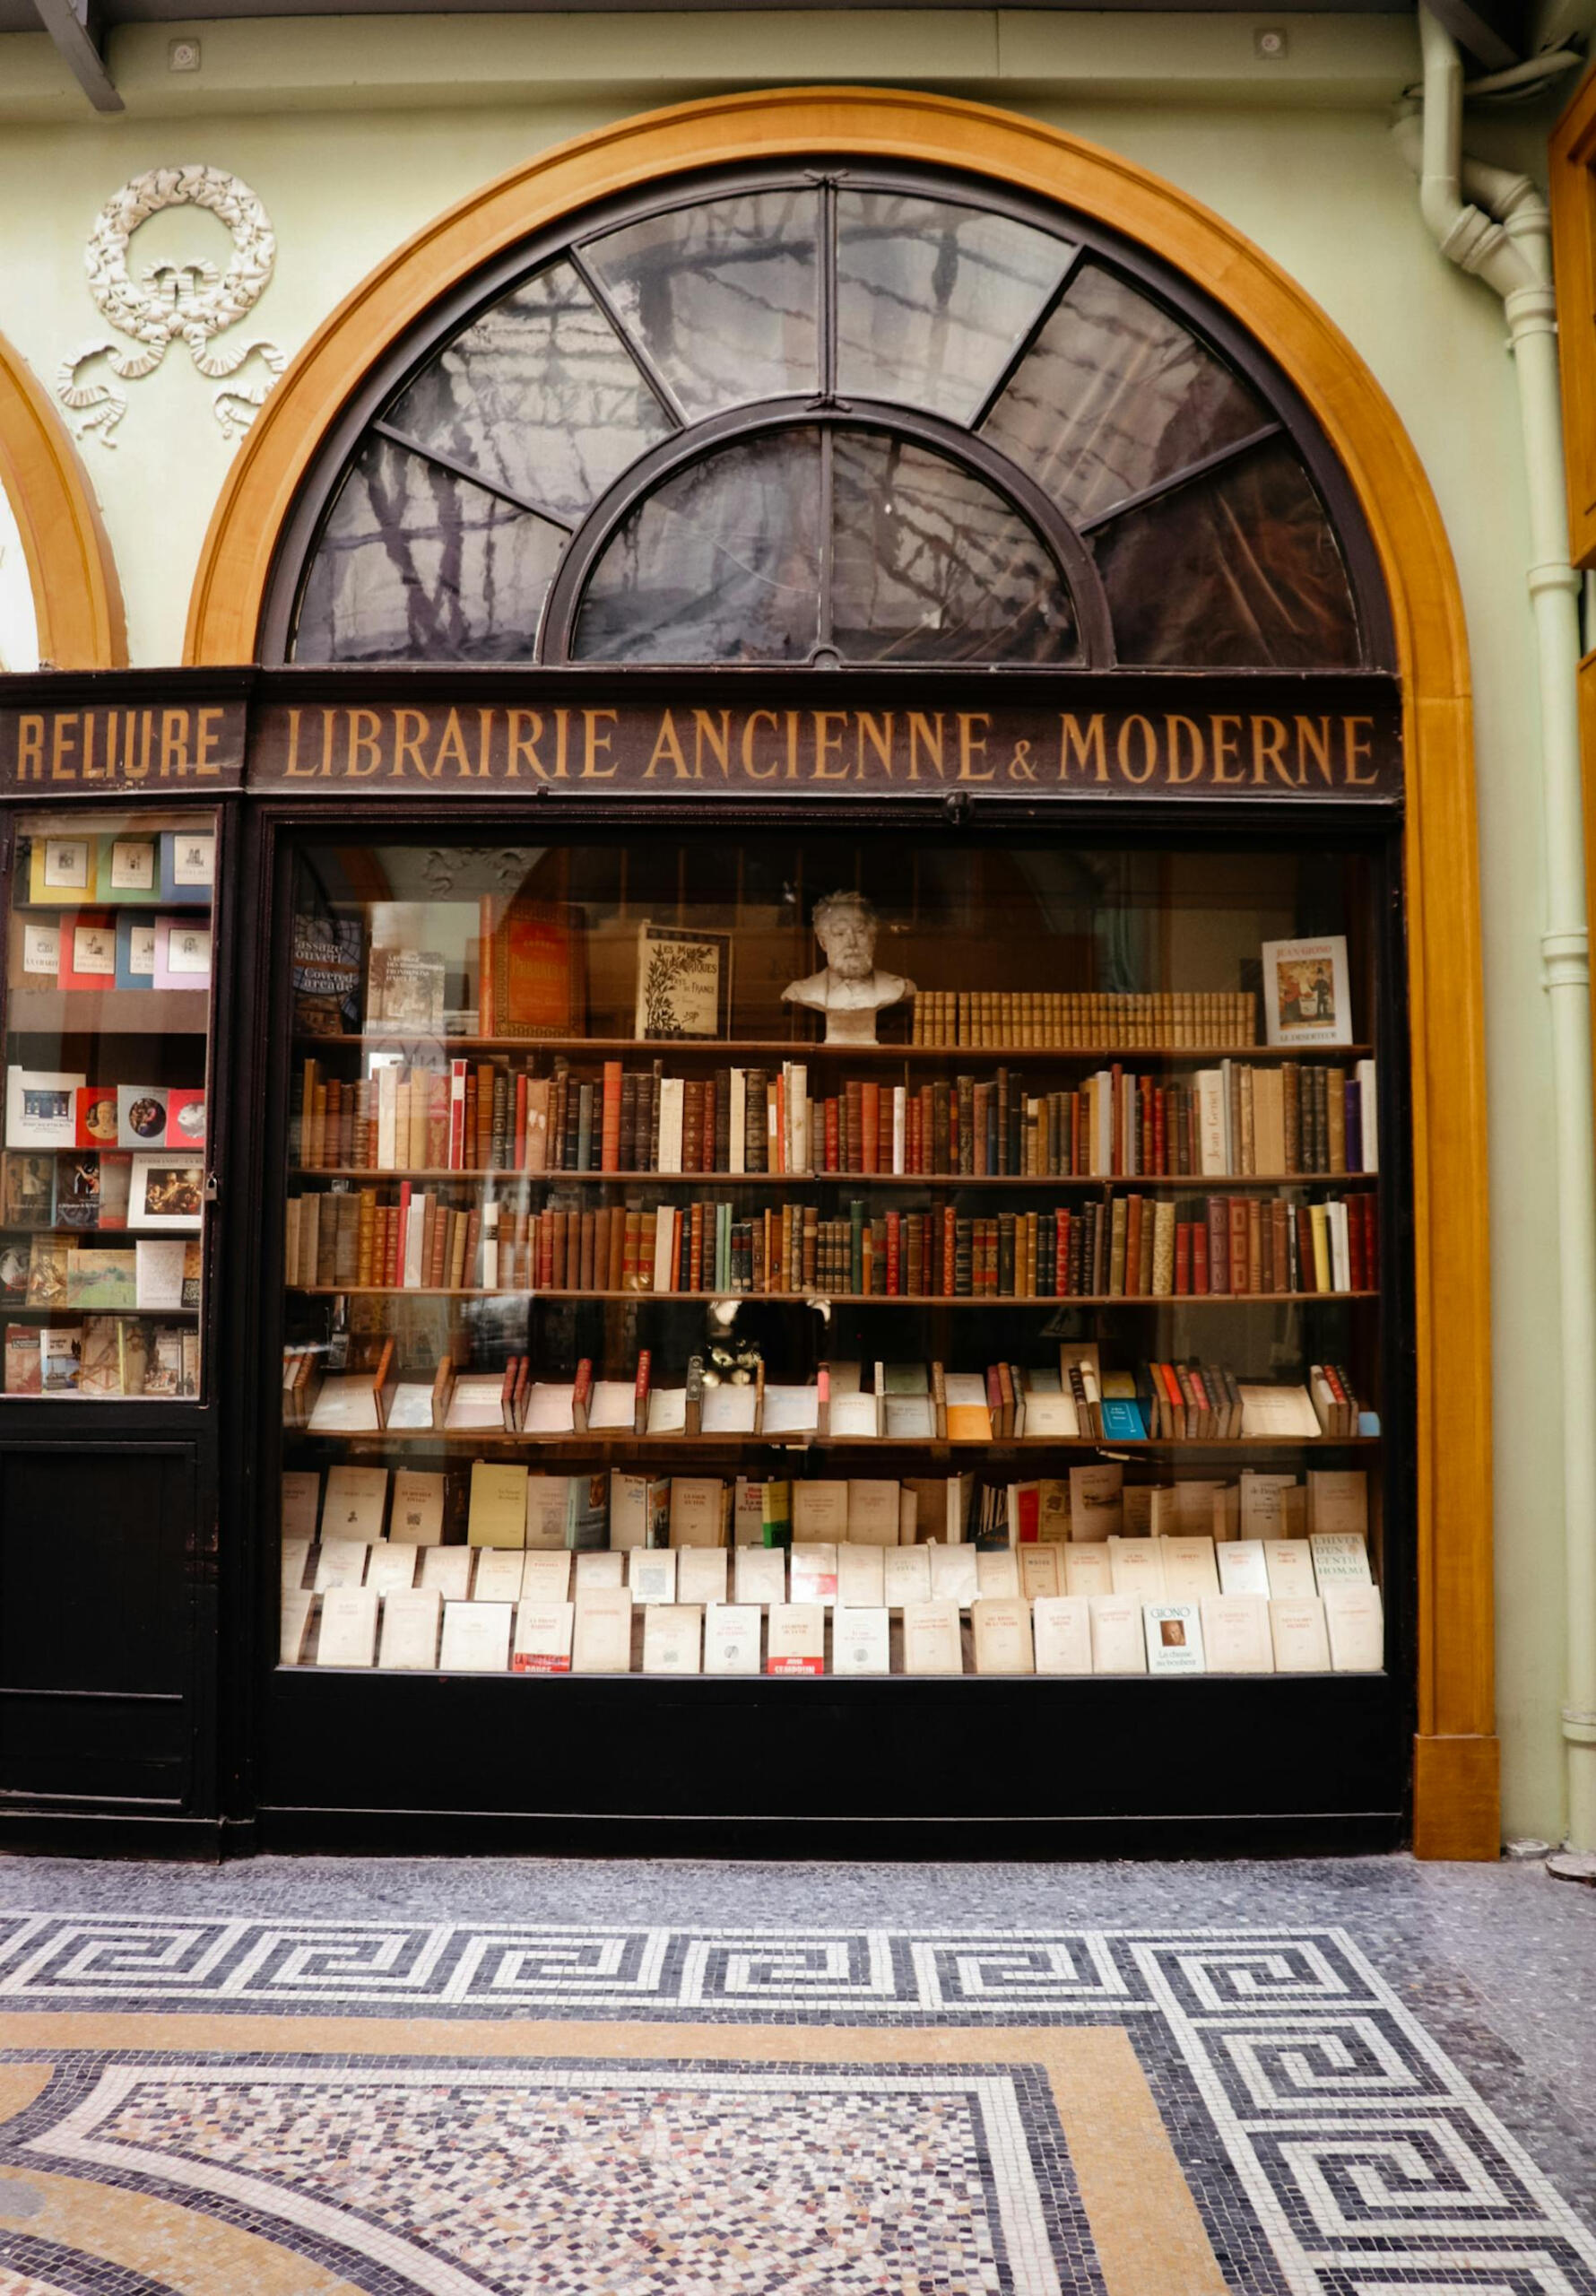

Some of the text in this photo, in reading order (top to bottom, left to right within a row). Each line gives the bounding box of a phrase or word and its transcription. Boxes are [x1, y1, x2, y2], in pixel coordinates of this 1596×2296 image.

[17, 708, 224, 780] RELIURE
[282, 708, 1379, 788] LIBRAIRIE ANCIENNE & MODERNE
[1150, 1606, 1191, 1619] GIONO
